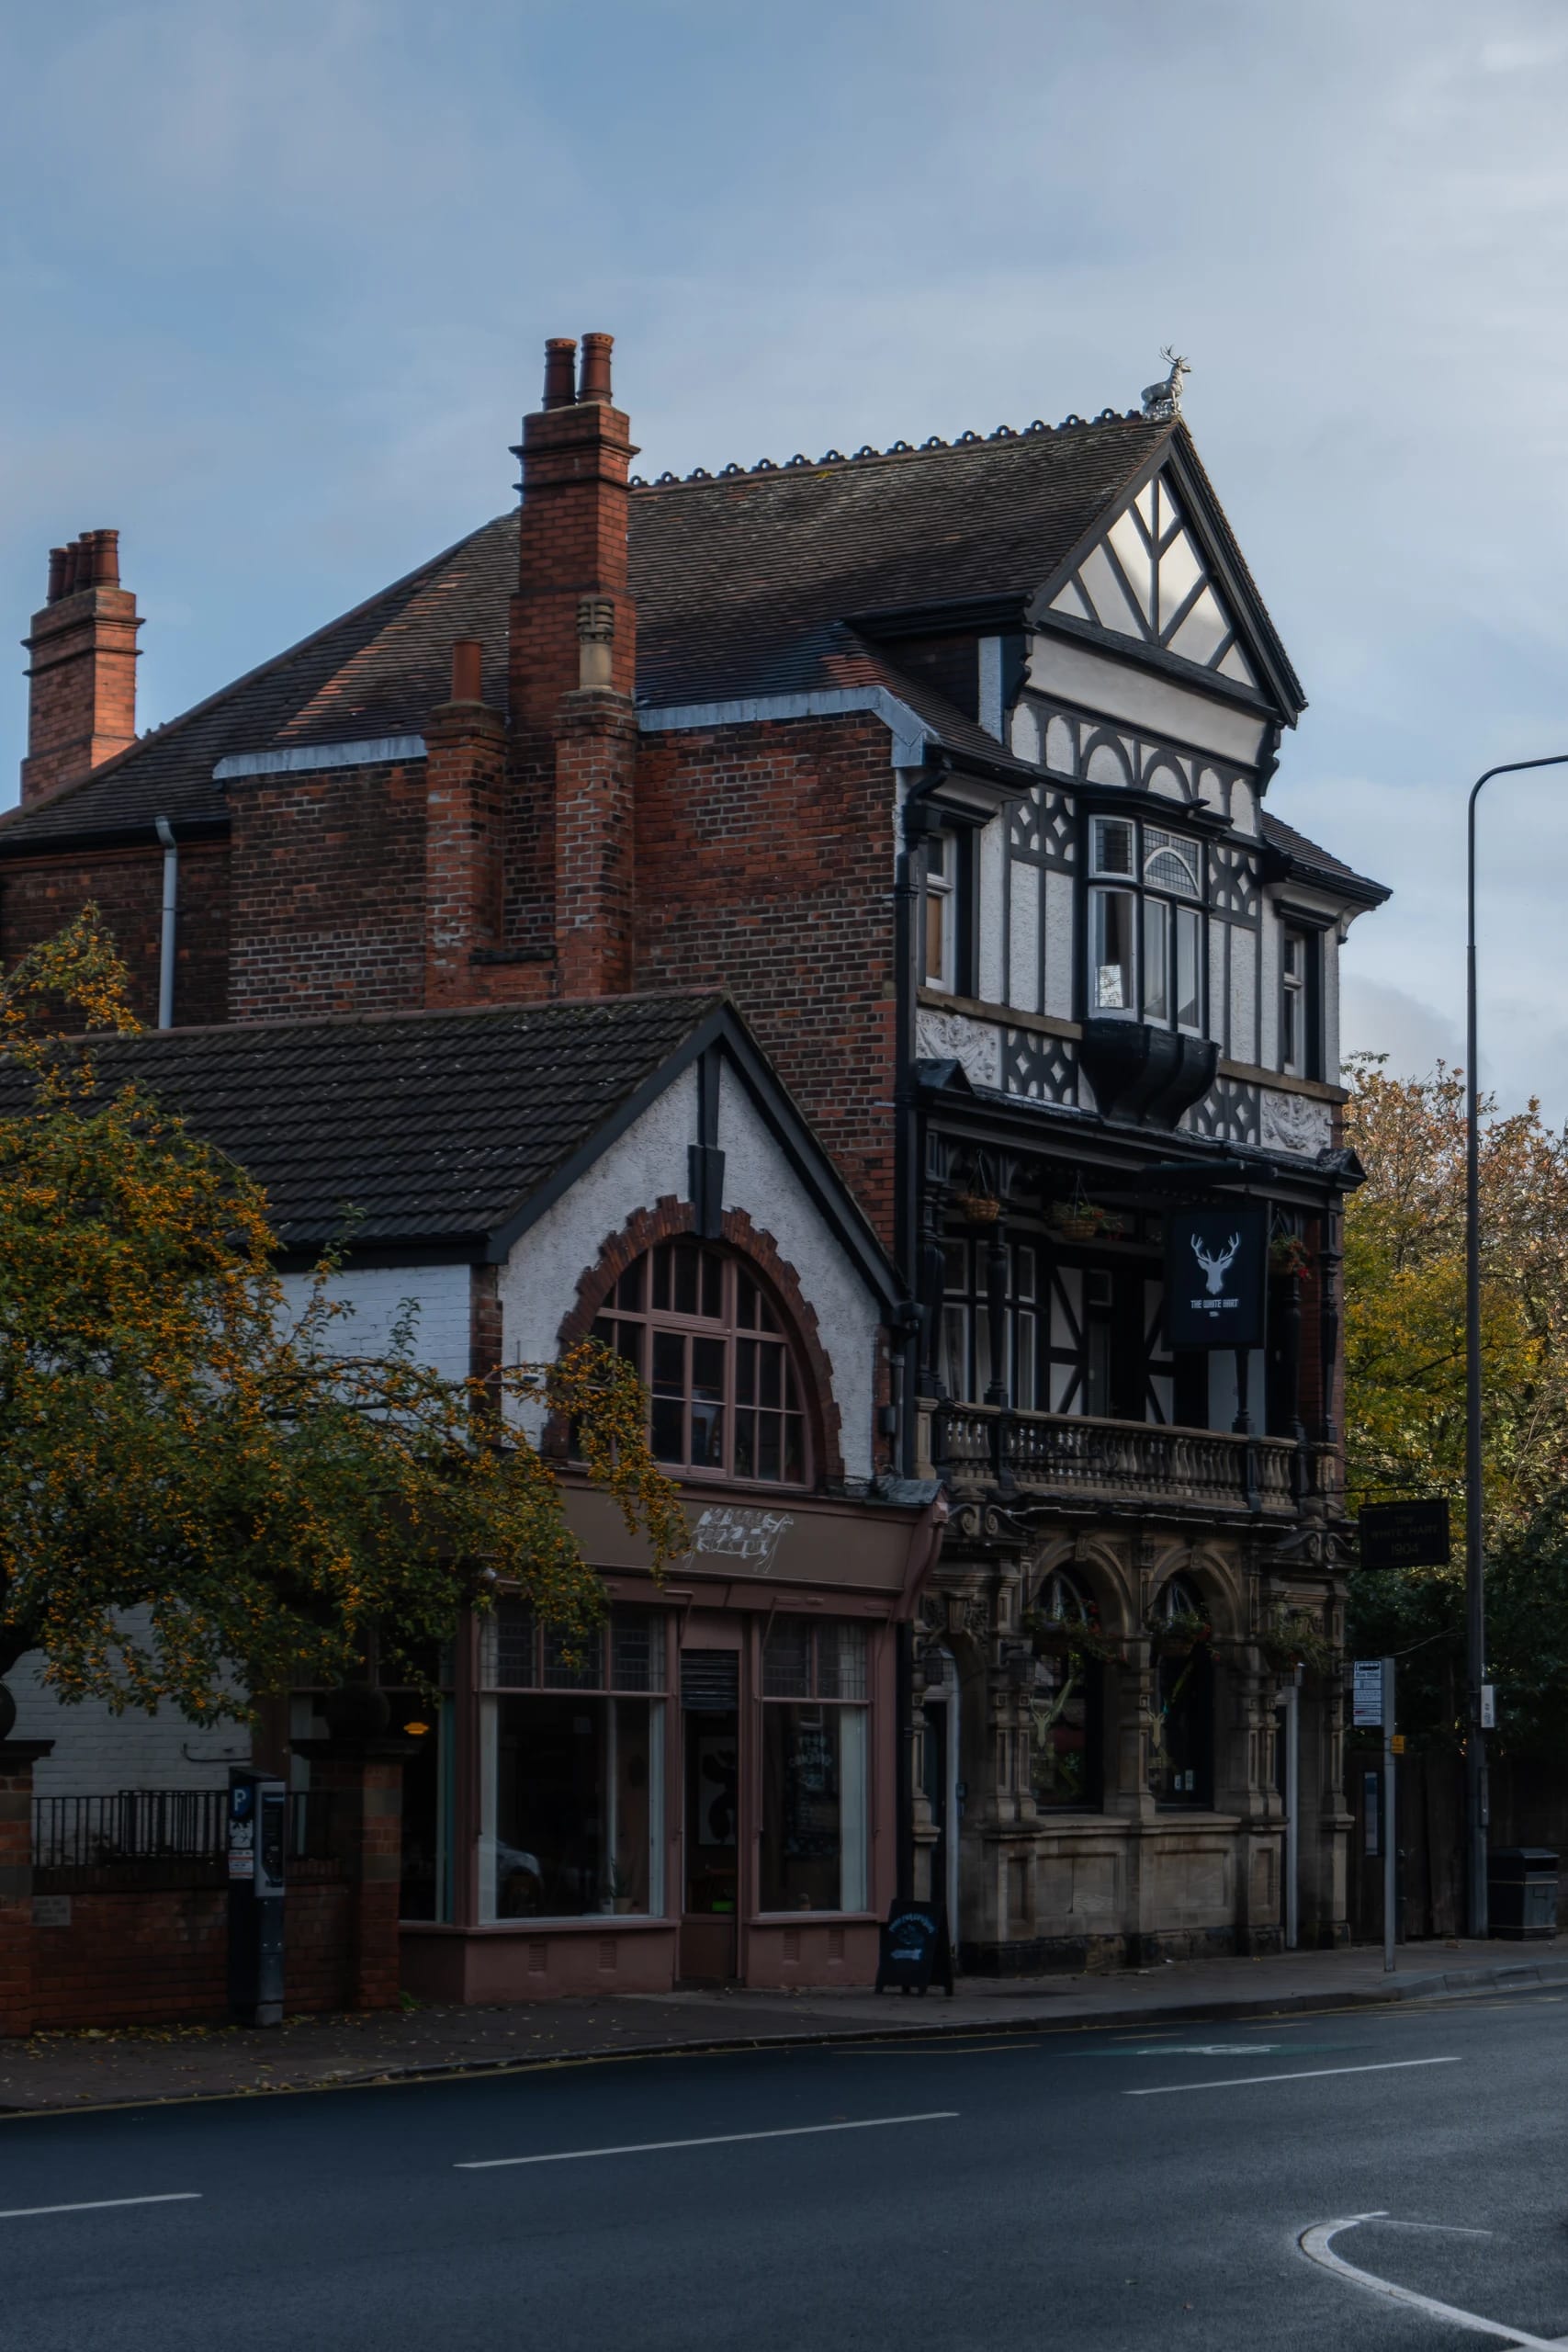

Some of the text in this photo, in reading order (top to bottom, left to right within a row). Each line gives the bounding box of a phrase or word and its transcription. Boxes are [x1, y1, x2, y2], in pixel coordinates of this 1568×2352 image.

[1190, 1300, 1202, 1308] THE
[1371, 1524, 1438, 1540] WHITE HART
[1392, 1543, 1418, 1556] 1904
[234, 1789, 246, 1812] P
